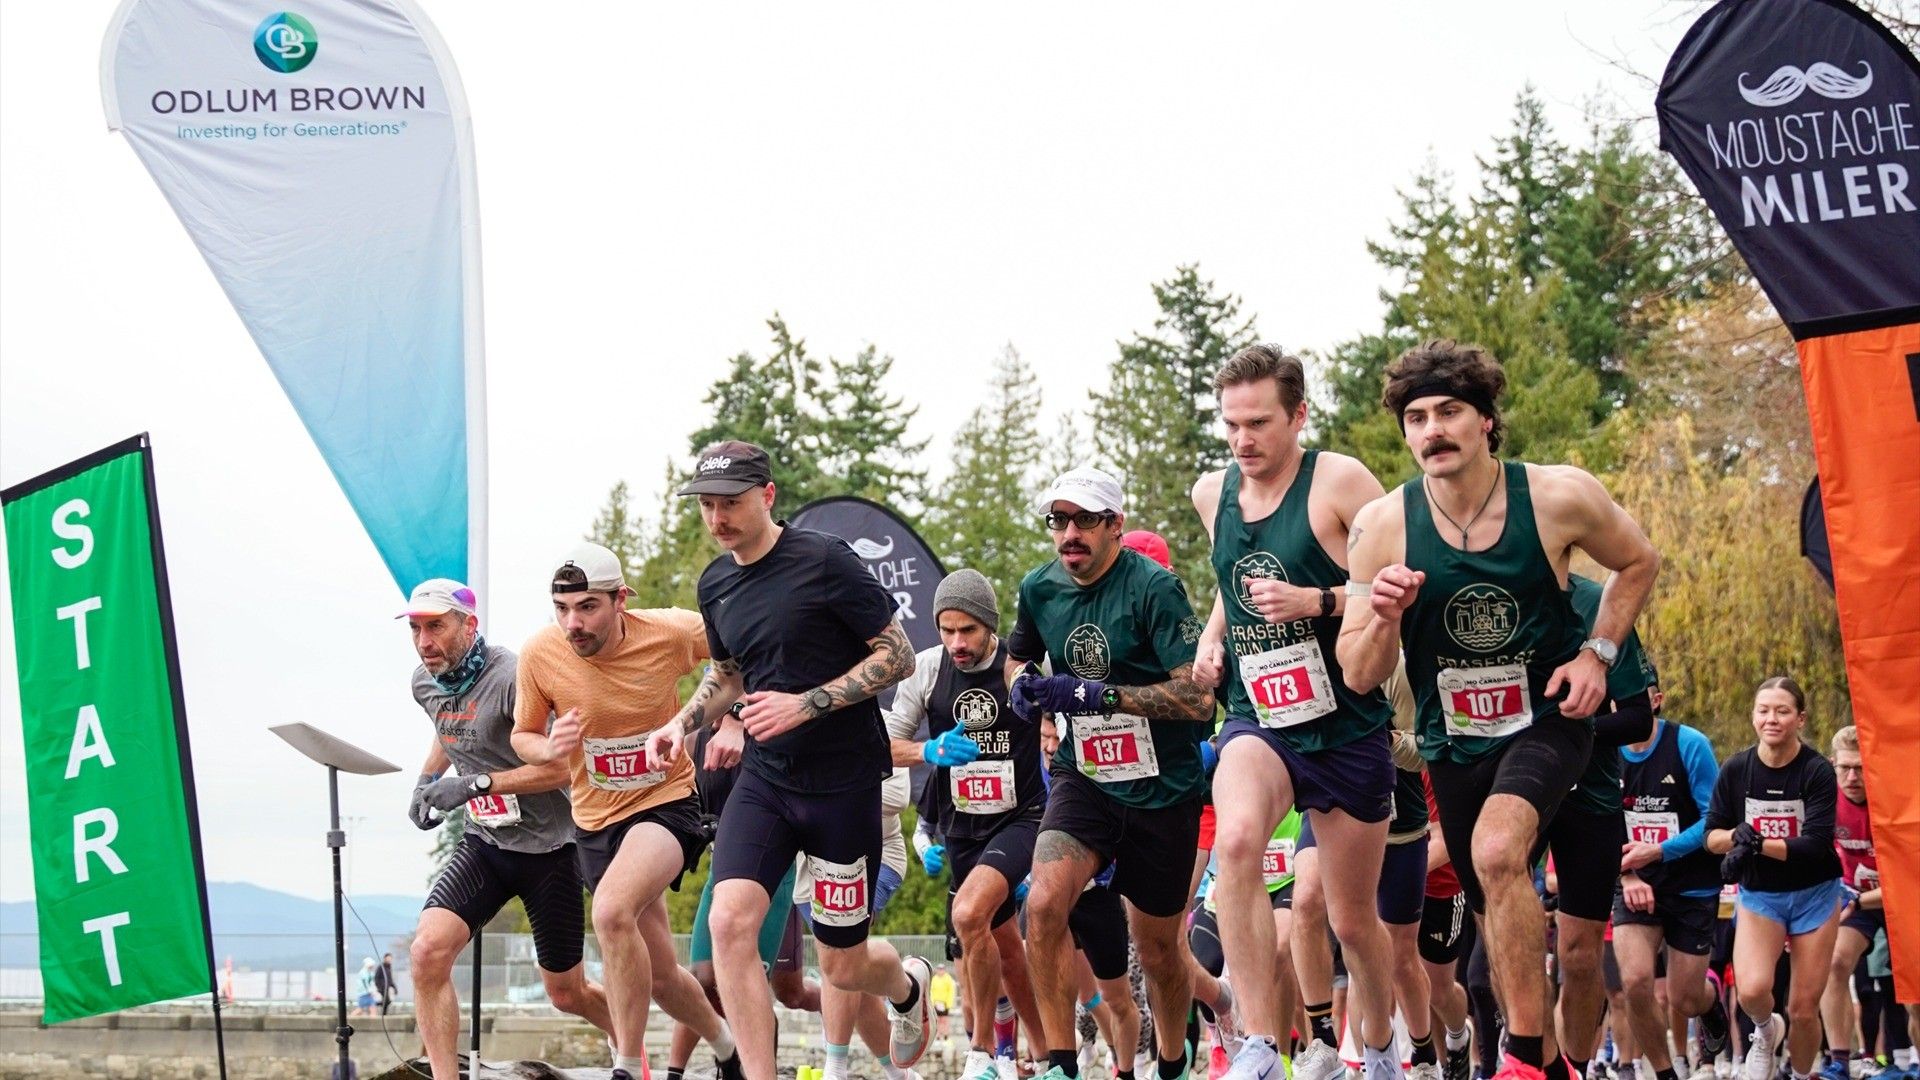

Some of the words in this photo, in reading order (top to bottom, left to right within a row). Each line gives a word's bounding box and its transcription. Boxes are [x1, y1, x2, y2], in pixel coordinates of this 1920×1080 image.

[151, 89, 277, 114] ODLUM
[290, 86, 425, 111] BROWN
[177, 124, 257, 140] Investing
[263, 123, 288, 137] for
[1706, 103, 1920, 170] MOUSTACHE
[1741, 163, 1917, 228] MILER
[700, 456, 731, 472] ciele
[1231, 622, 1288, 641] FRASER
[1293, 618, 1315, 637] ST
[1269, 659, 1292, 668] CANADA
[1261, 673, 1299, 705] 173
[1479, 677, 1506, 685] CANADA
[1466, 690, 1506, 717] 107
[51, 498, 131, 987] START
[978, 742, 1010, 754] CLUB
[1093, 737, 1123, 763] 137
[606, 754, 638, 775] 157
[966, 779, 993, 798] 154
[472, 795, 499, 814] 124
[1638, 828, 1660, 844] 147
[1760, 819, 1790, 838] 533
[823, 884, 857, 908] 140
